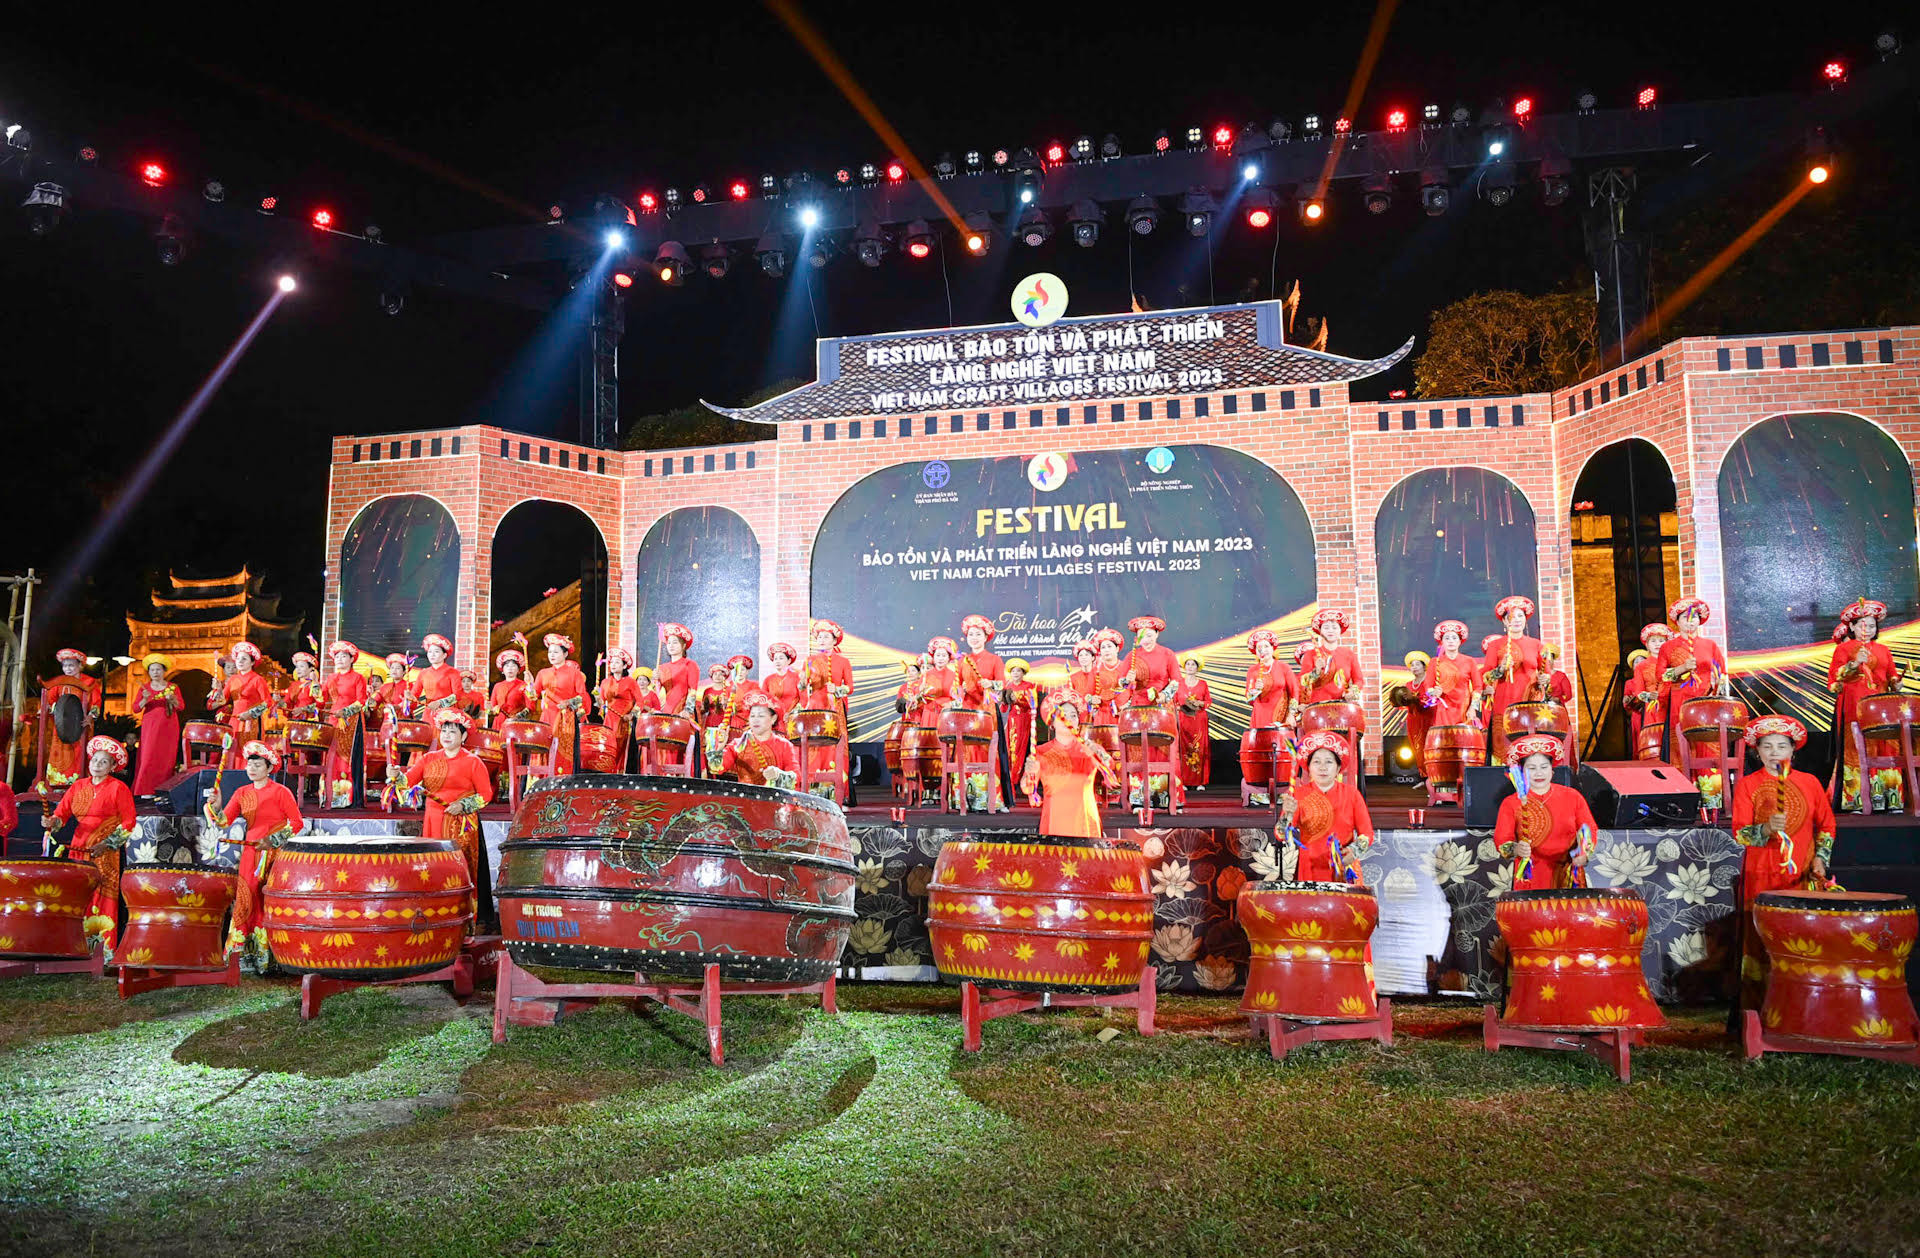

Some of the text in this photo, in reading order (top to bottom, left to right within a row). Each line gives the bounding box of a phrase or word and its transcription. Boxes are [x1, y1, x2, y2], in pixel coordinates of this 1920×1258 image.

[866, 313, 1224, 366] FESTIVAL BẢO TỒN VÀ PHÁT TRIỂN
[930, 350, 1156, 385] LÀNG NGHỀ VIỆT NAM
[871, 367, 1224, 409] VIET NAM CRAFT VILLAGES FESTIVAL 2023
[976, 502, 1126, 538] FESTIVAL
[863, 536, 1253, 566] BẢO TỒN VÀ PHÁT TRIỂN LÀNG NGHỀ VIỆT NAM 2023
[910, 558, 1200, 581] VIET NAM CRAFT VILLAGES FESTIVAL 2023
[993, 611, 1058, 633] Tài hoa
[1057, 625, 1081, 648] giá
